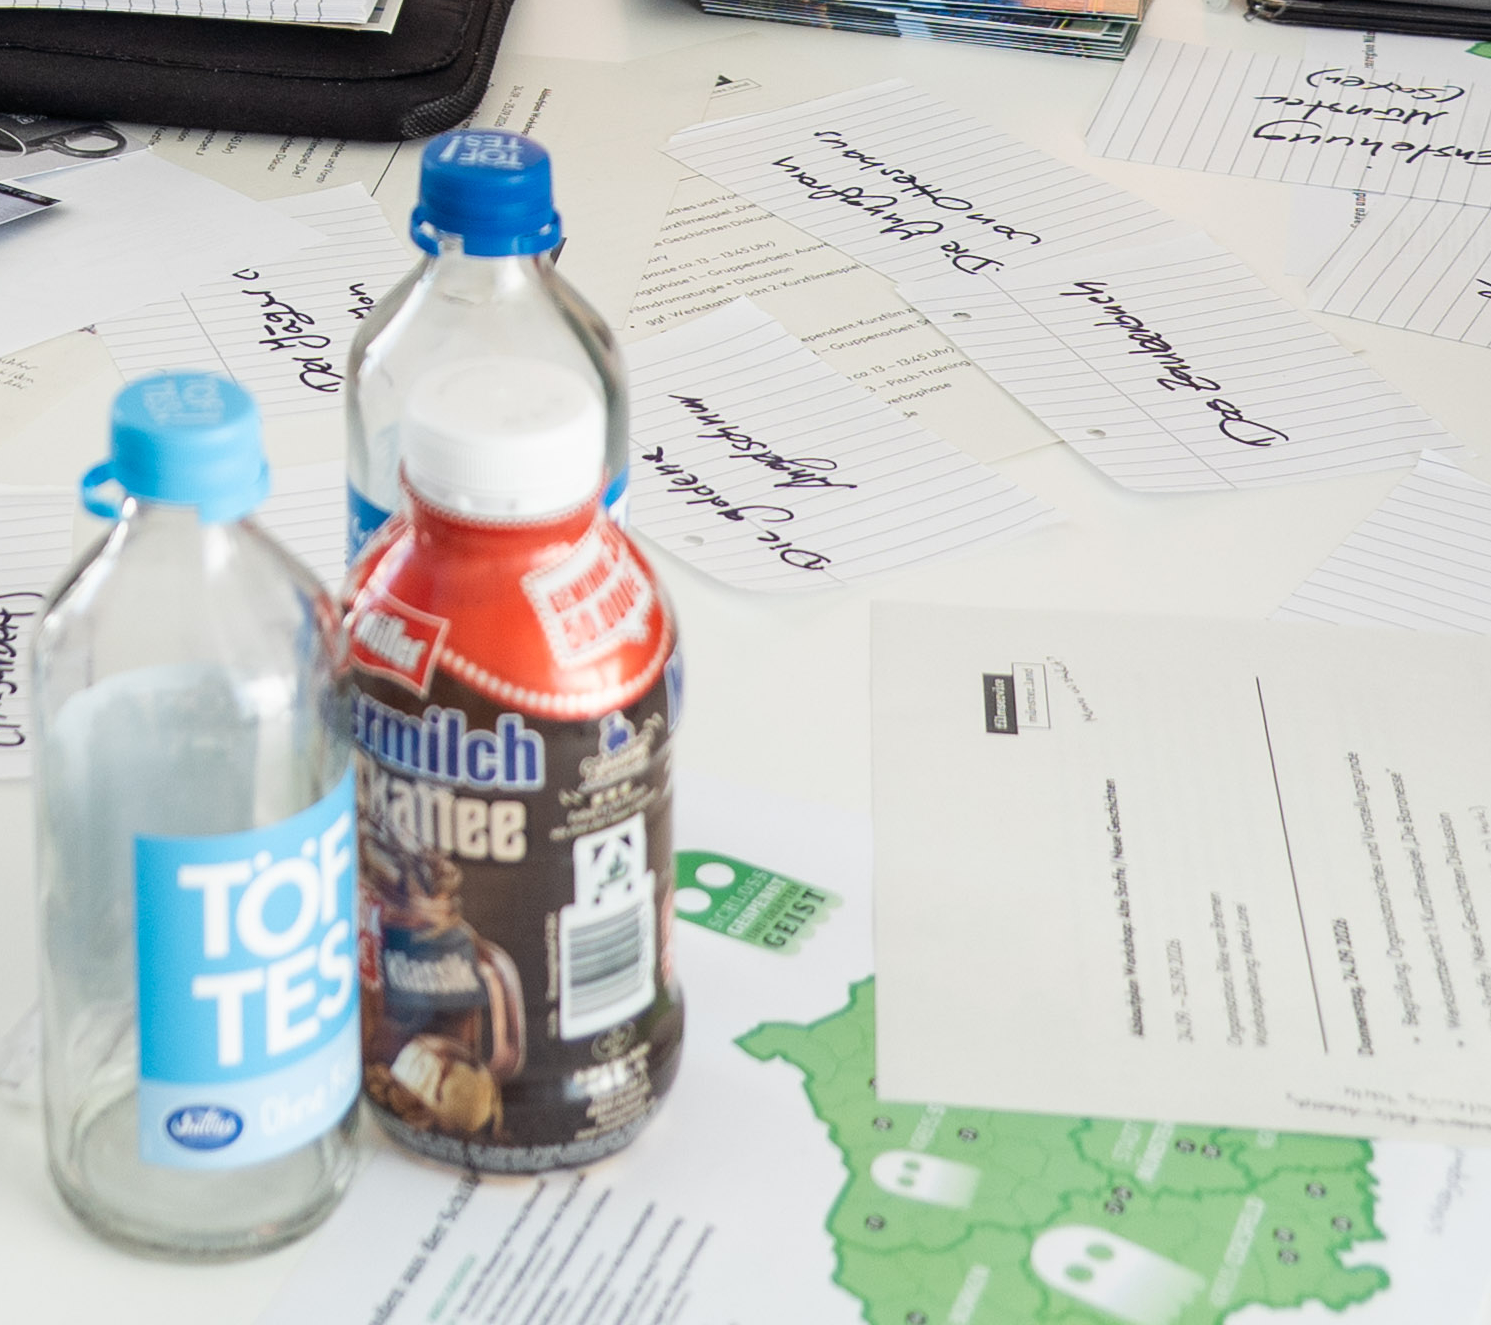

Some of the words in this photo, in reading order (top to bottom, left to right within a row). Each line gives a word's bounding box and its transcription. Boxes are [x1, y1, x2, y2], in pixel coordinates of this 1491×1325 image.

[941, 238, 1004, 276] Die
[1072, 281, 1219, 394] Zauberbuch
[1206, 398, 1291, 450] Das
[759, 531, 830, 572] Die
[177, 809, 352, 960] TÖF
[759, 888, 828, 950] GEIST
